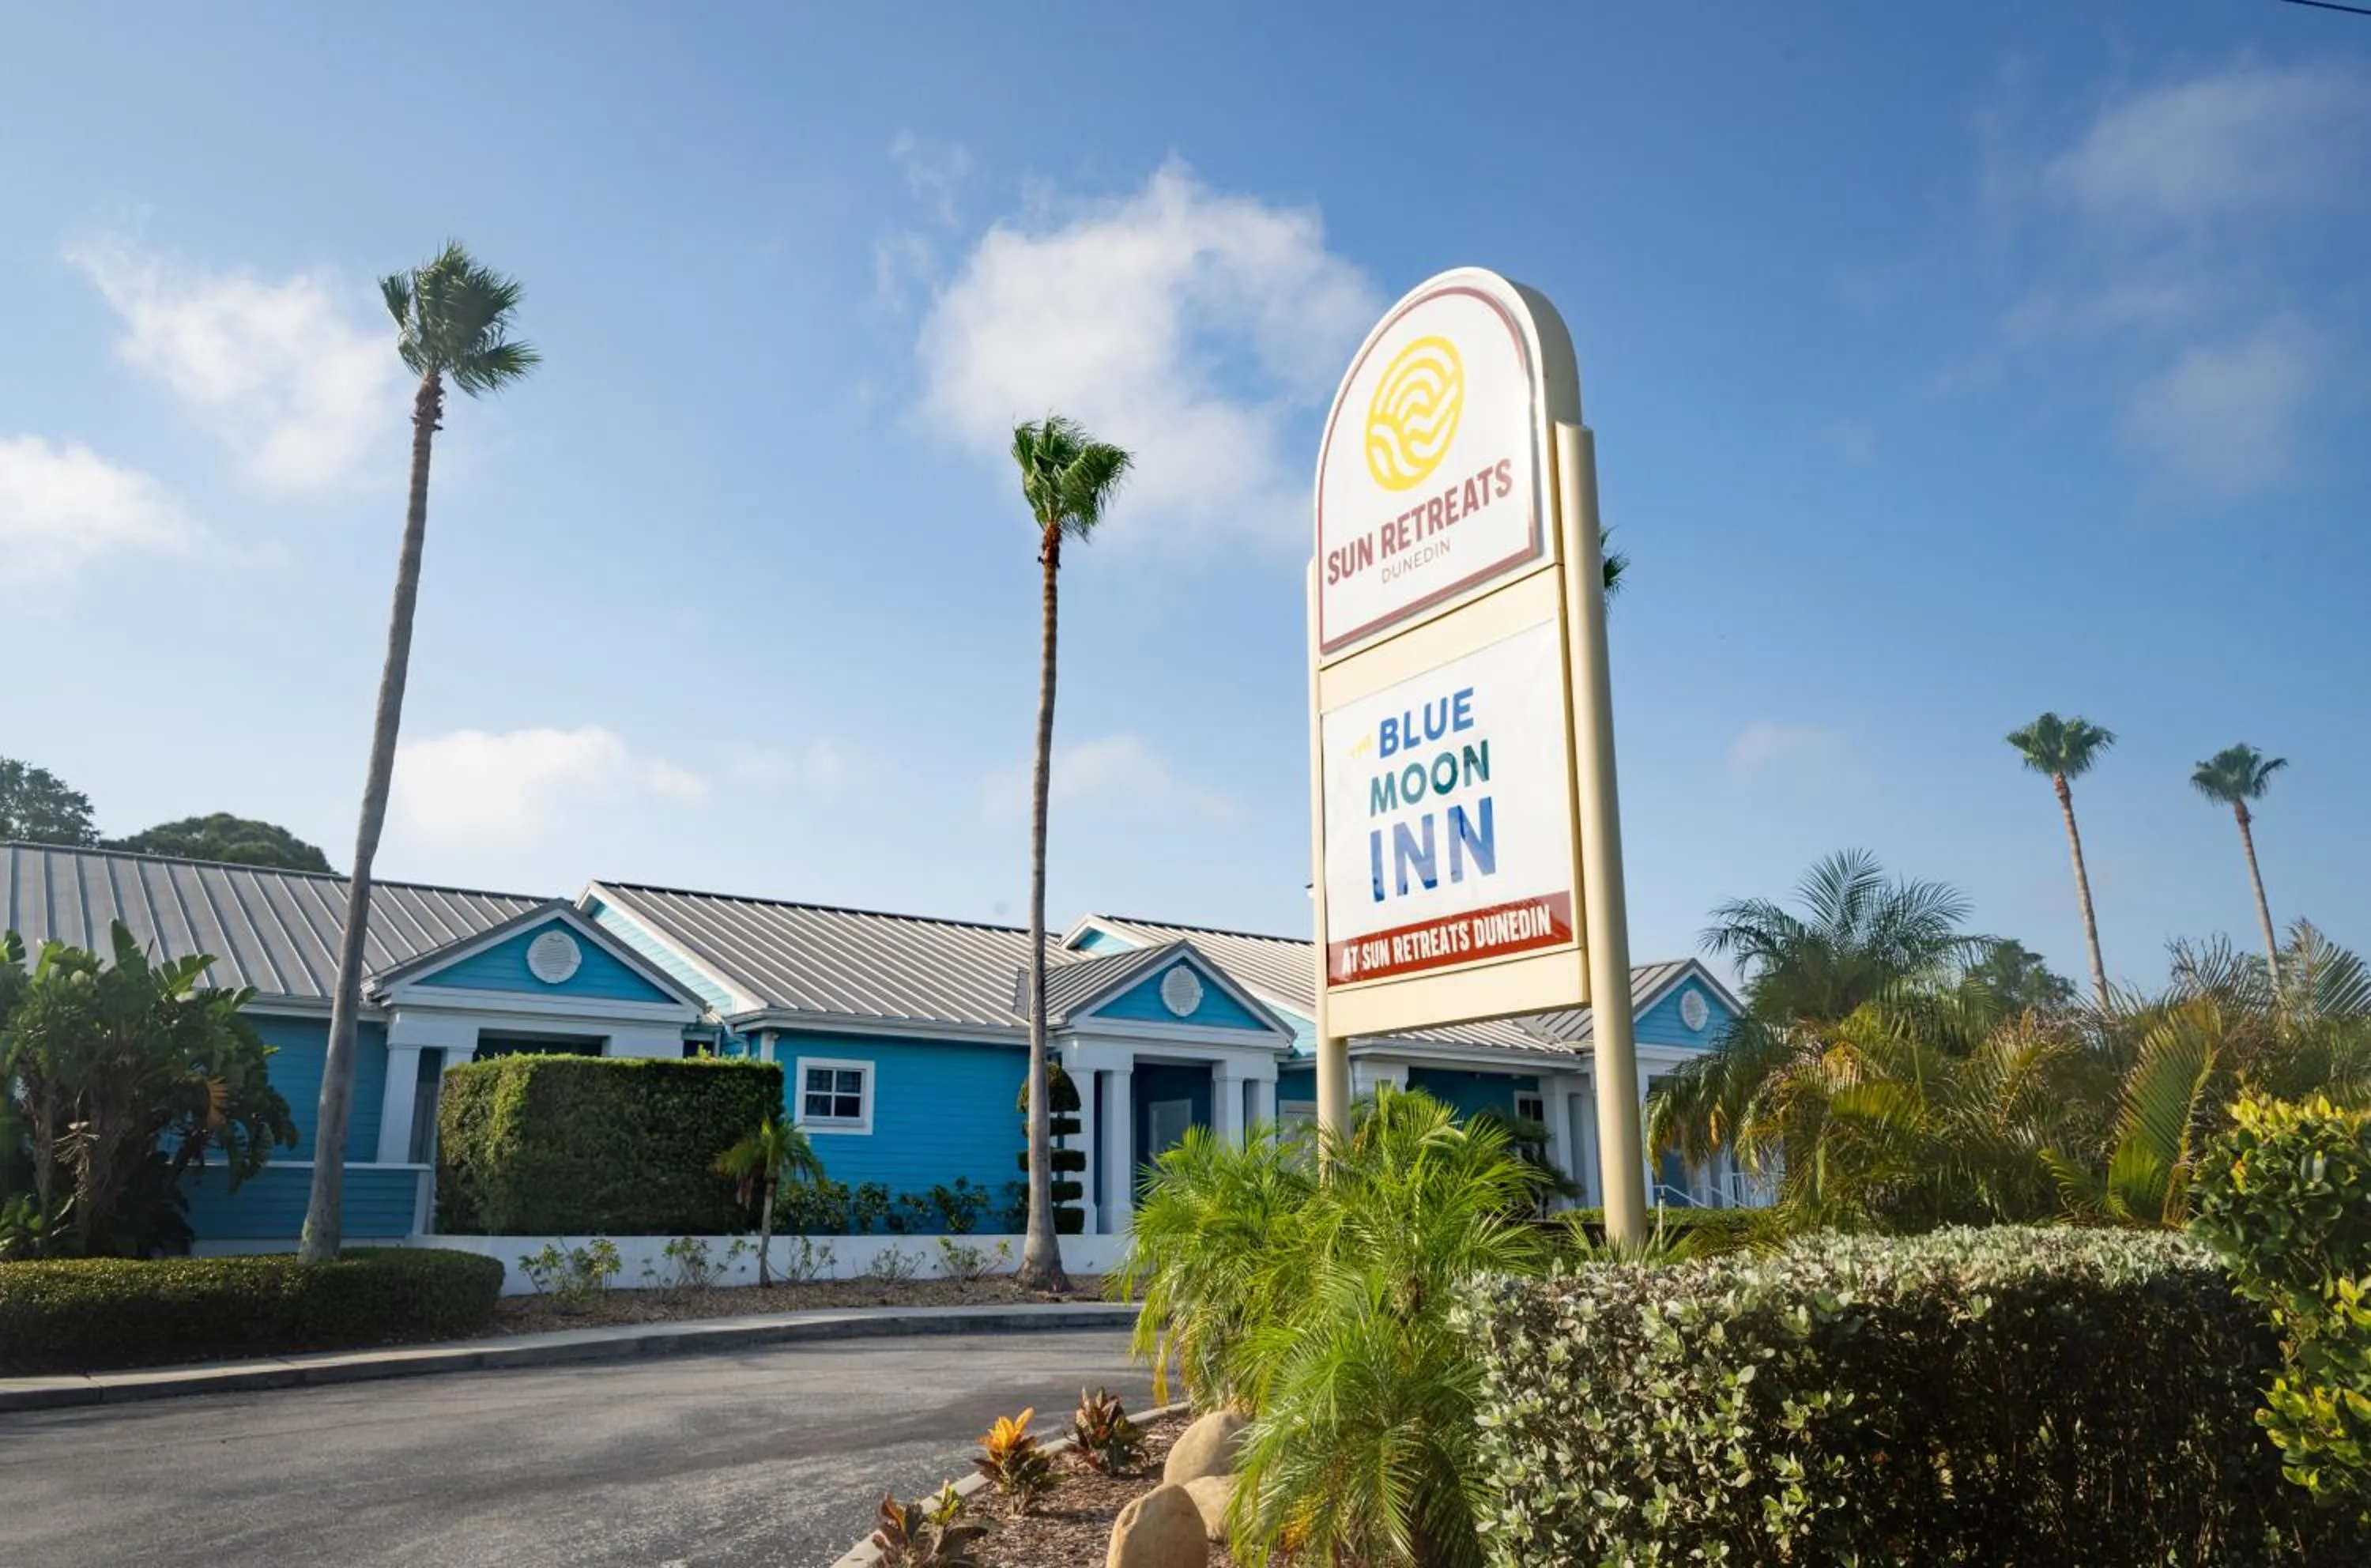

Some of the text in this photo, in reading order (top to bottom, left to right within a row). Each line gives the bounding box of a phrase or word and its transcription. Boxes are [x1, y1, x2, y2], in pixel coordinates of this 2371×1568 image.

[1327, 458, 1513, 586] SUN RETREATS
[1381, 539, 1451, 584] DUNEDIN
[1379, 687, 1474, 759] BLUE
[1370, 739, 1490, 817] MOON
[1370, 796, 1496, 903] INN
[1341, 903, 1551, 975] AT SUN RETREATS DUNEDIN
